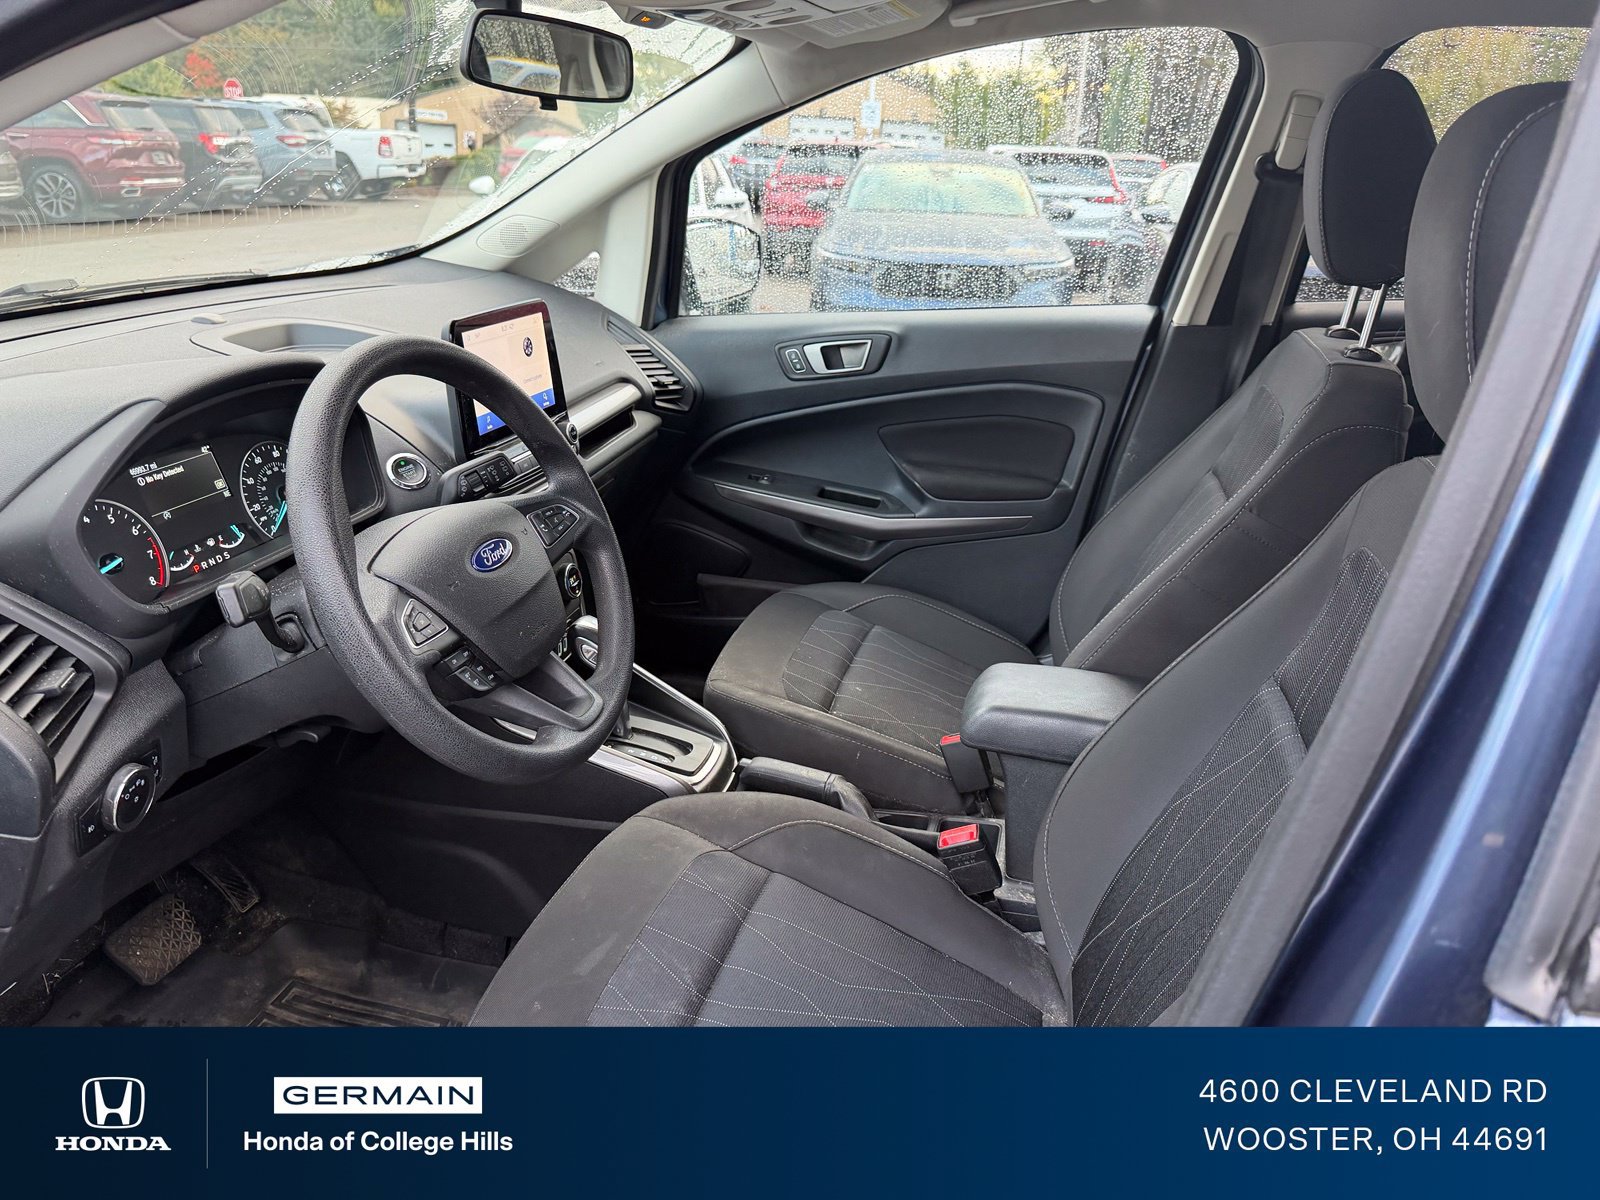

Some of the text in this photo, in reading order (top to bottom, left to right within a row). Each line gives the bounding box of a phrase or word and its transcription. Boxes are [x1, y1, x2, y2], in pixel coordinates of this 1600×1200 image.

[254, 456, 262, 464] 60
[150, 462, 158, 470] mi
[145, 465, 185, 484] No Key Detected
[246, 477, 255, 485] 40
[83, 516, 90, 524] 4
[107, 514, 115, 524] 5
[132, 526, 139, 536] 6
[146, 550, 154, 559] 7
[480, 543, 510, 566] Ford
[149, 576, 157, 586] 8
